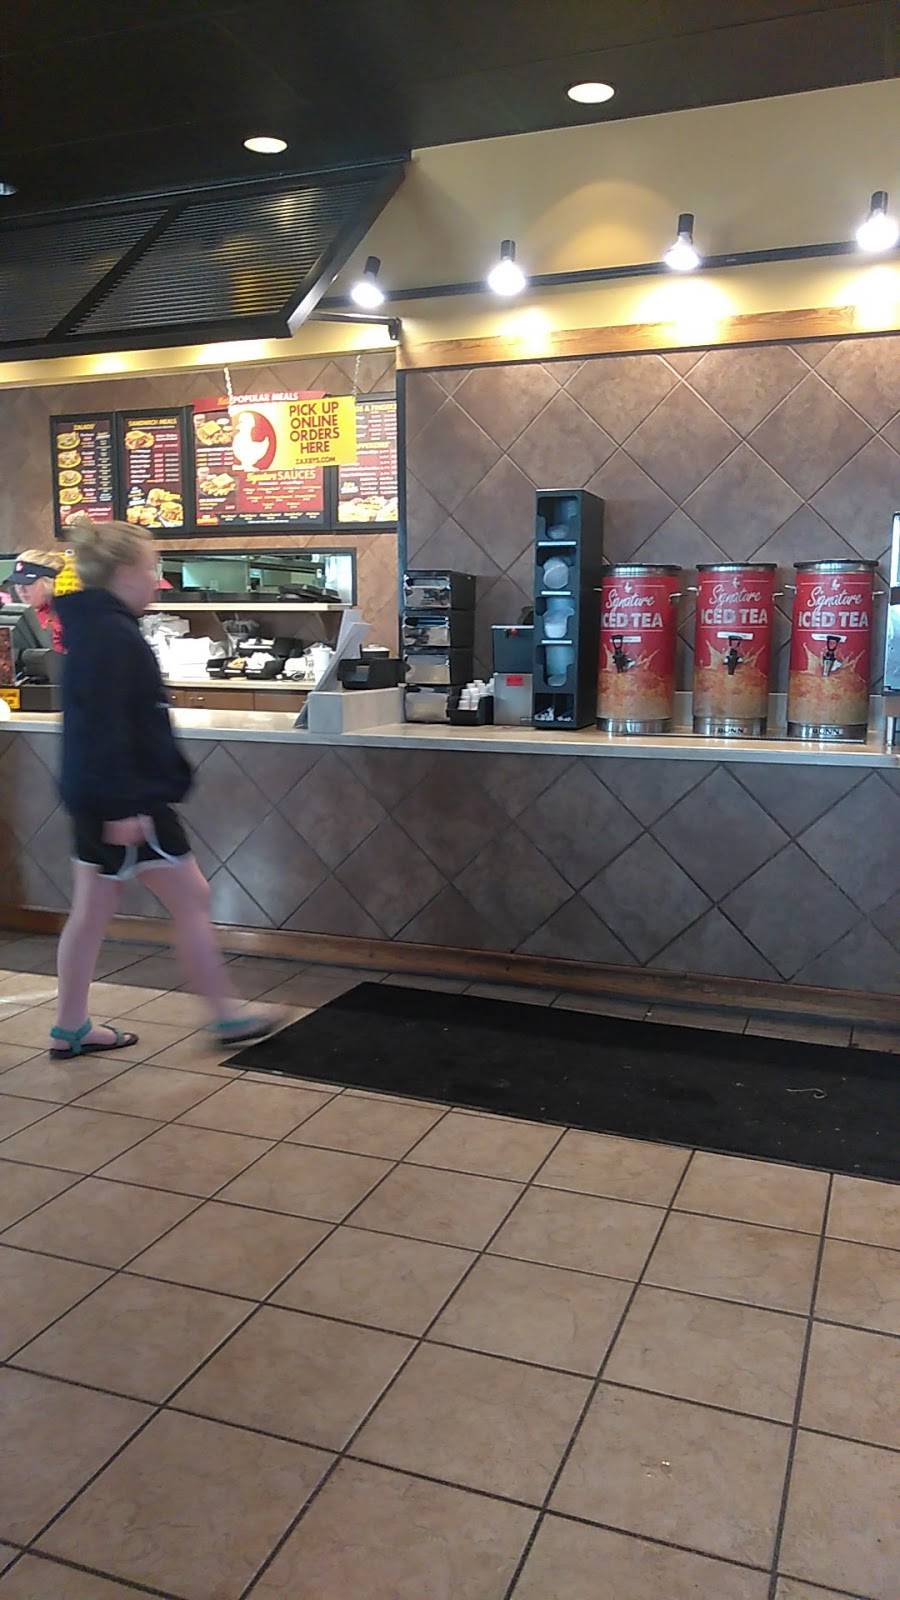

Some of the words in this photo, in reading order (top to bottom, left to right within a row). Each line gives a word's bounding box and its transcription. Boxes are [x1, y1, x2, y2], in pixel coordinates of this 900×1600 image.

[271, 392, 299, 401] MEALS
[289, 403, 317, 417] PICK
[322, 401, 339, 415] UP
[290, 414, 338, 430] ONLINE
[290, 427, 340, 442] ORDERS
[300, 440, 330, 454] HERE
[277, 470, 316, 480] SAUCES
[606, 588, 655, 613] Signature
[709, 584, 761, 609] Signature
[807, 586, 862, 612] Signature
[602, 612, 629, 628] CED
[630, 612, 664, 628] TEA
[701, 608, 737, 625] ICED
[739, 608, 768, 625] TEA
[798, 611, 835, 628] ICED
[838, 611, 869, 628] TEA
